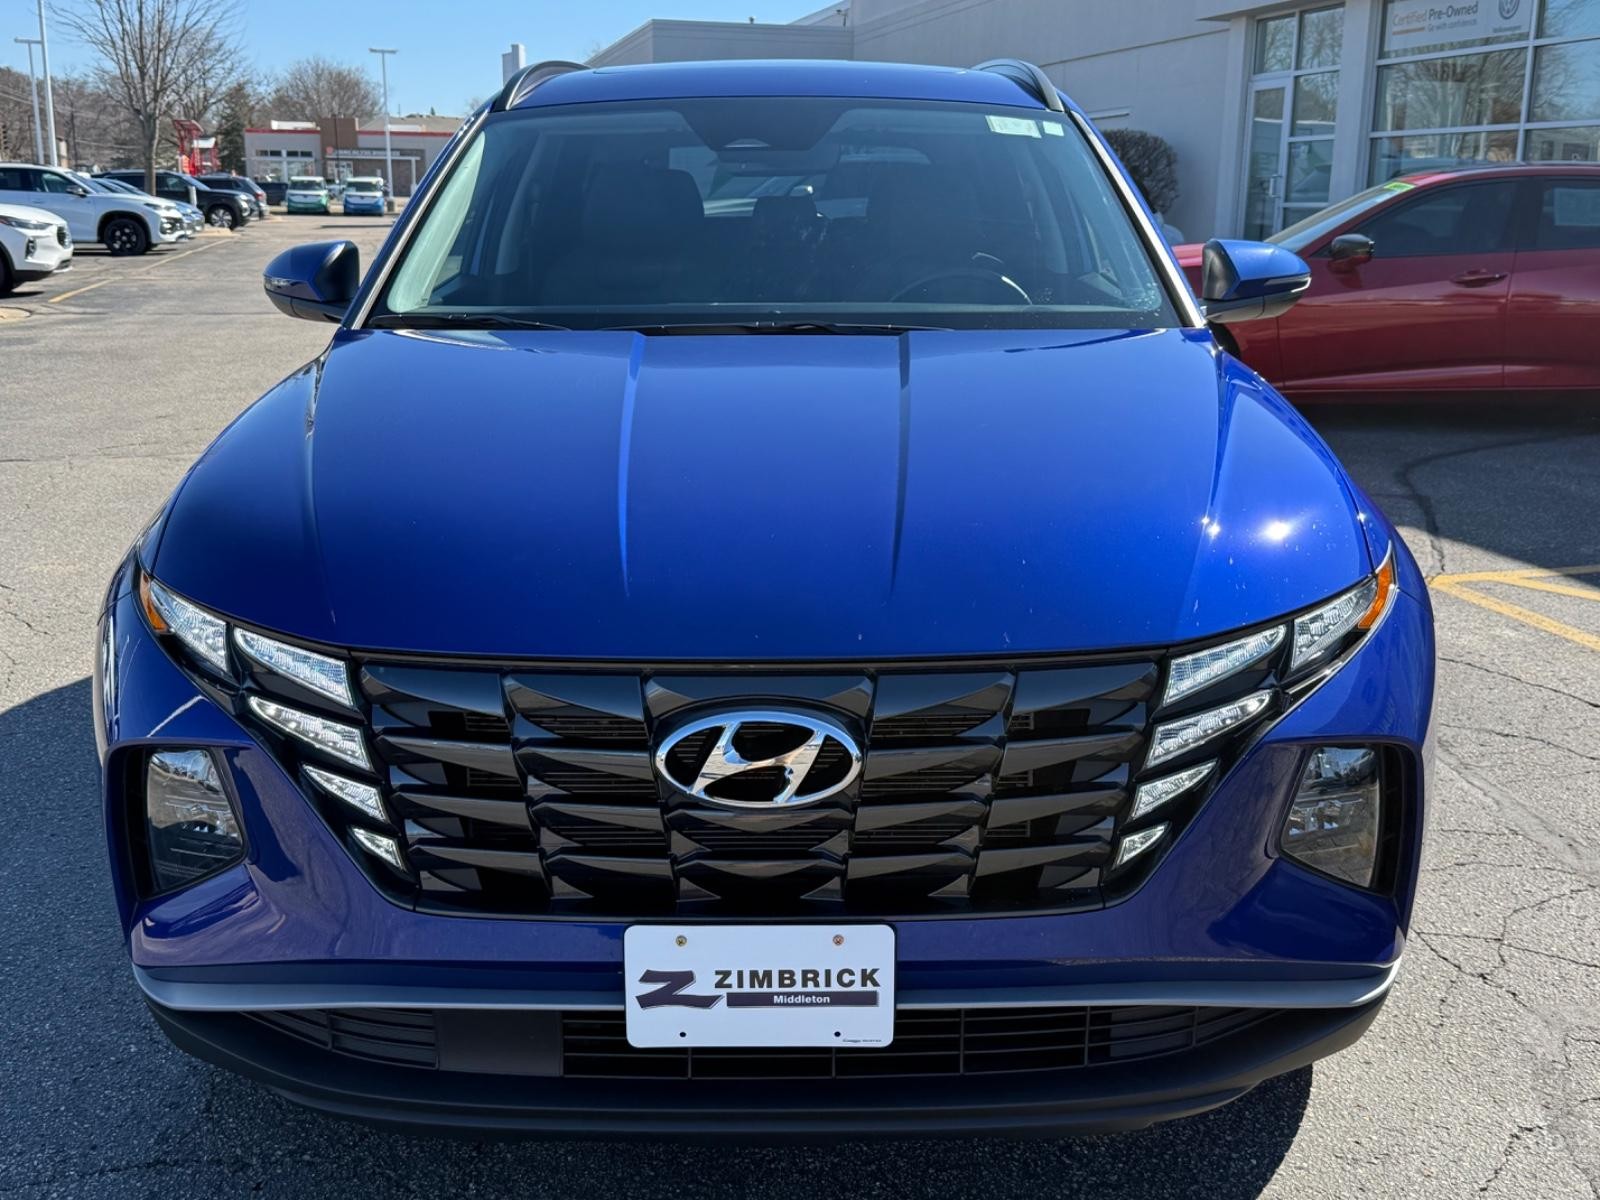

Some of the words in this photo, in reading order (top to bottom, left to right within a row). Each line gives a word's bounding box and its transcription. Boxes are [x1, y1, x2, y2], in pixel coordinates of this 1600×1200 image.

[1392, 9, 1427, 26] Certified
[1428, 1, 1479, 20] Pre-Owned
[714, 968, 881, 989] ZIMBRICK
[773, 994, 831, 1004] Middleton
